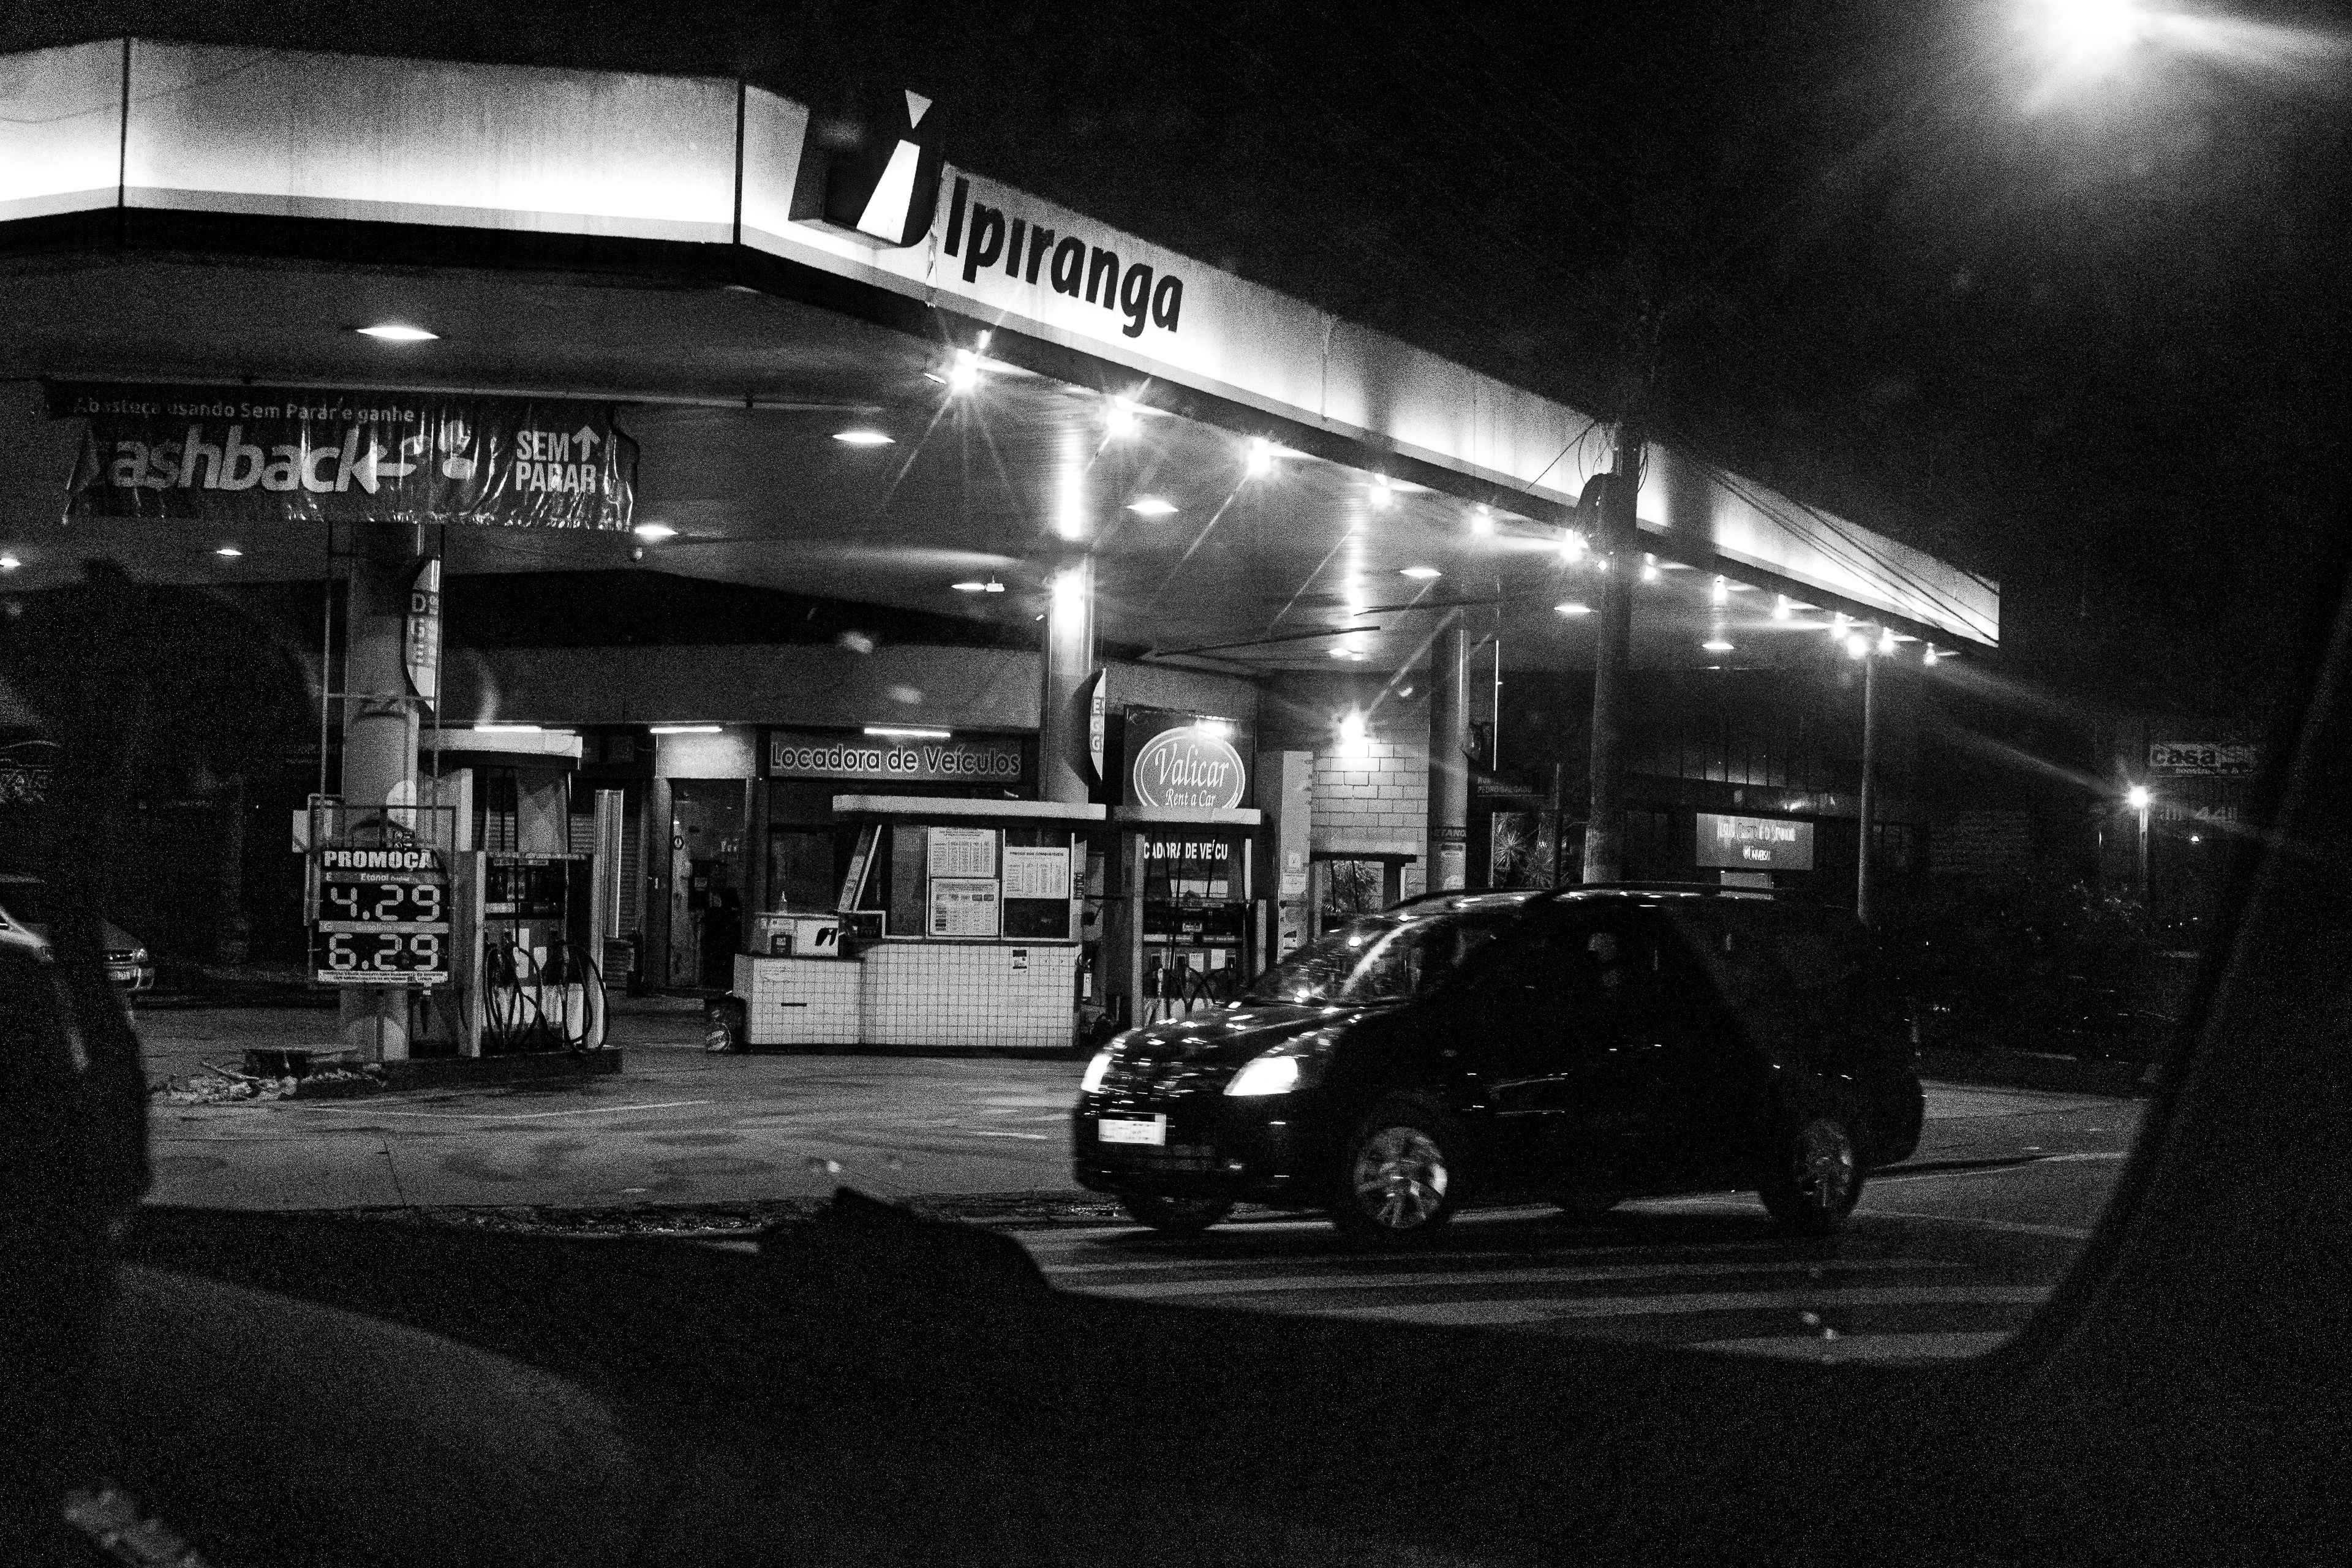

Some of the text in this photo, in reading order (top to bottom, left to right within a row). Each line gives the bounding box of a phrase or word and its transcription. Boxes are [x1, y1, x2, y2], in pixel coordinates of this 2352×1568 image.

[943, 176, 1183, 337] Ipiranga
[167, 401, 235, 417] usando
[241, 402, 280, 418] Sem
[286, 403, 336, 420] Parar
[342, 407, 352, 420] e
[358, 405, 415, 424] ganhe
[108, 424, 388, 494] ashback
[516, 430, 570, 462] SEM
[516, 461, 597, 493] PARAR
[771, 742, 1021, 776] Locadora de Veículos
[1155, 742, 1230, 788] Valicar
[2152, 749, 2216, 764] casa
[1165, 788, 1216, 807] Rent a Car
[323, 848, 440, 872] PROMOÇÃ
[1185, 842, 1197, 859] DE
[330, 884, 441, 921] 4.29
[328, 933, 439, 971] 6.29
